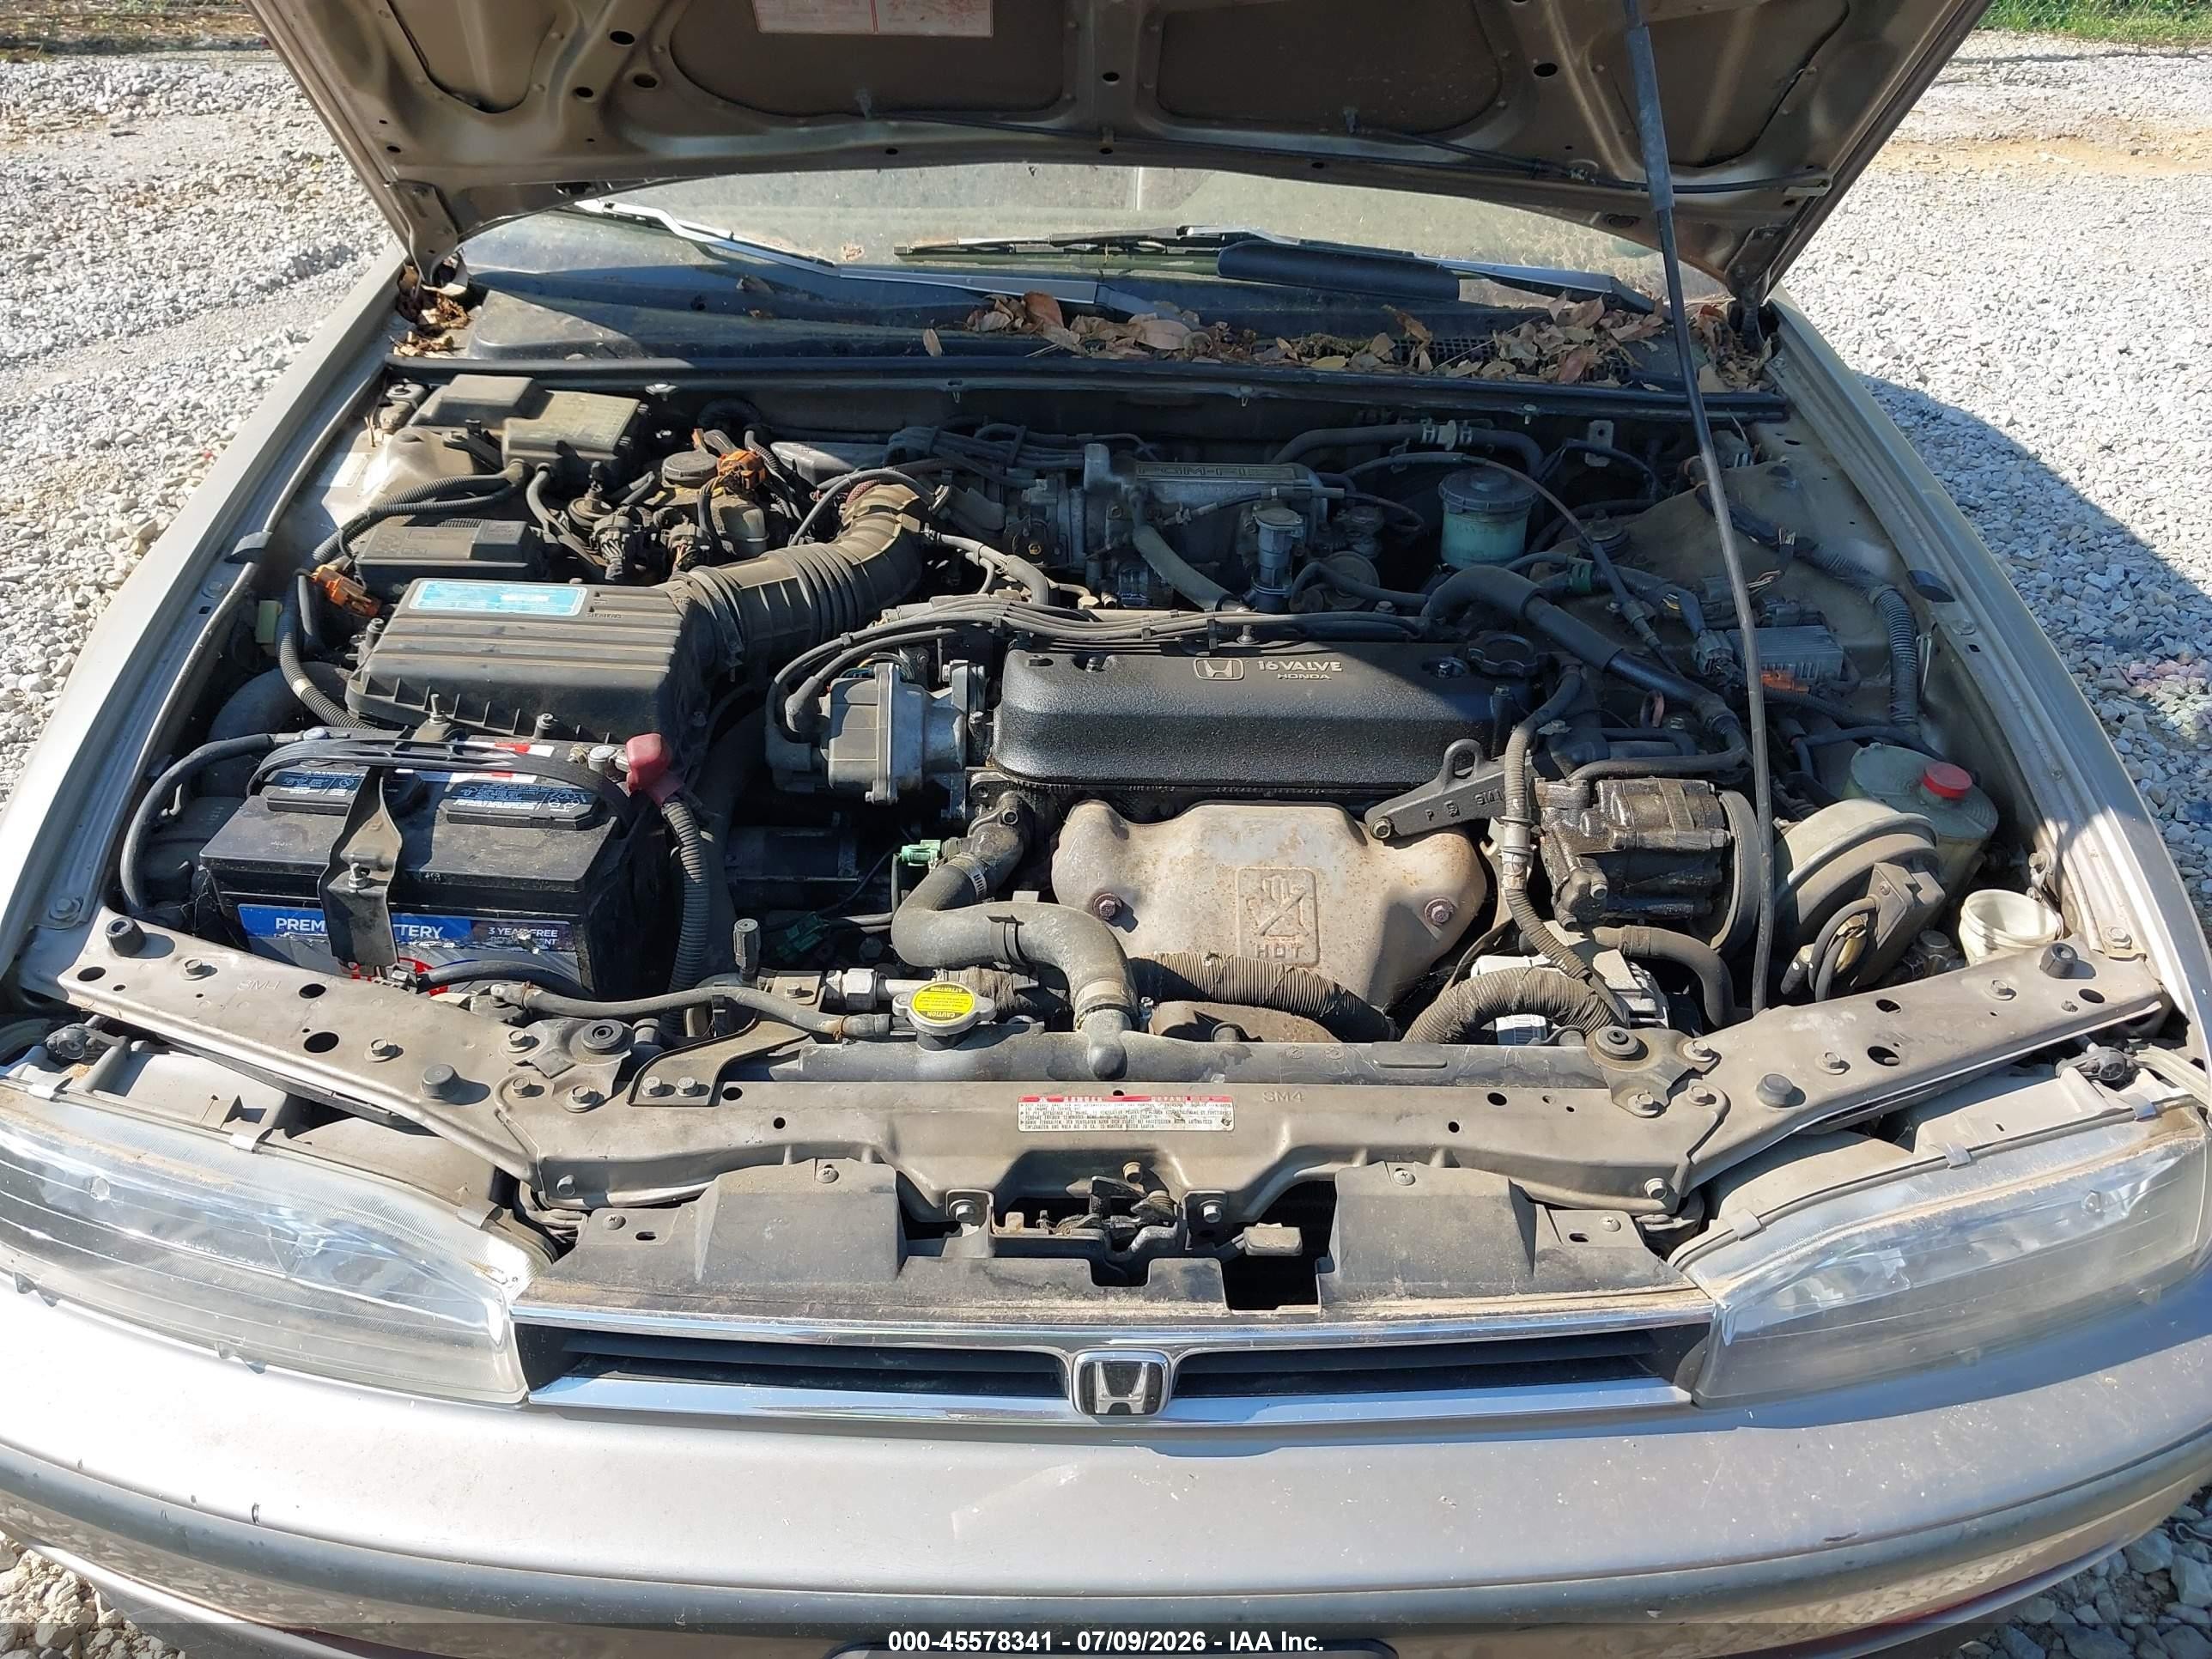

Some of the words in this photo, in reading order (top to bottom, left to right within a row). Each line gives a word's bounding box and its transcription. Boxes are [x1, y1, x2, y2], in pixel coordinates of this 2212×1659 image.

[275, 917, 325, 933] PREM
[488, 927, 495, 935] 3
[1255, 942, 1304, 958] HOT
[1262, 1091, 1304, 1103] SM4
